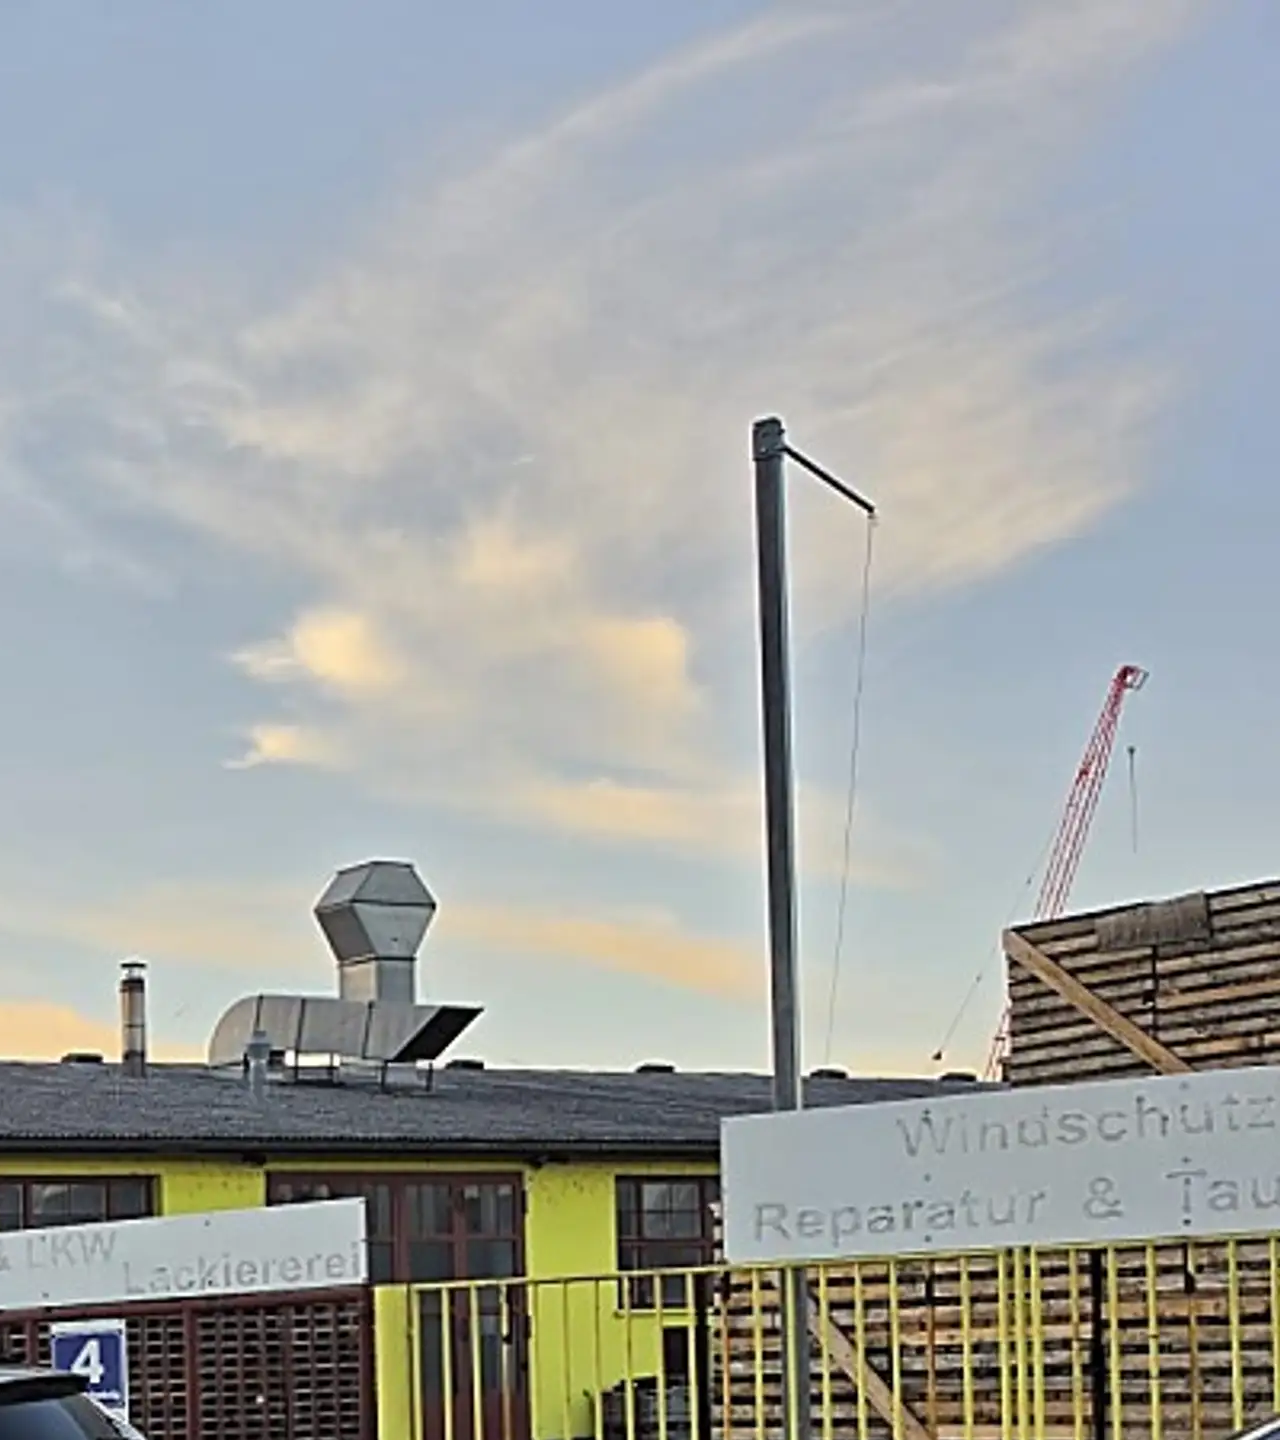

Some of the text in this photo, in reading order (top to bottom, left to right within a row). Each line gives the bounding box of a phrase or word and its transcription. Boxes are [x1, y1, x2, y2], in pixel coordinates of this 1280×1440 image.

[753, 1188, 1047, 1248] Reparatur
[1082, 1175, 1125, 1220] &
[26, 1230, 118, 1271] LKW
[123, 1241, 361, 1297] Lackiererei
[70, 1339, 105, 1384] 4
